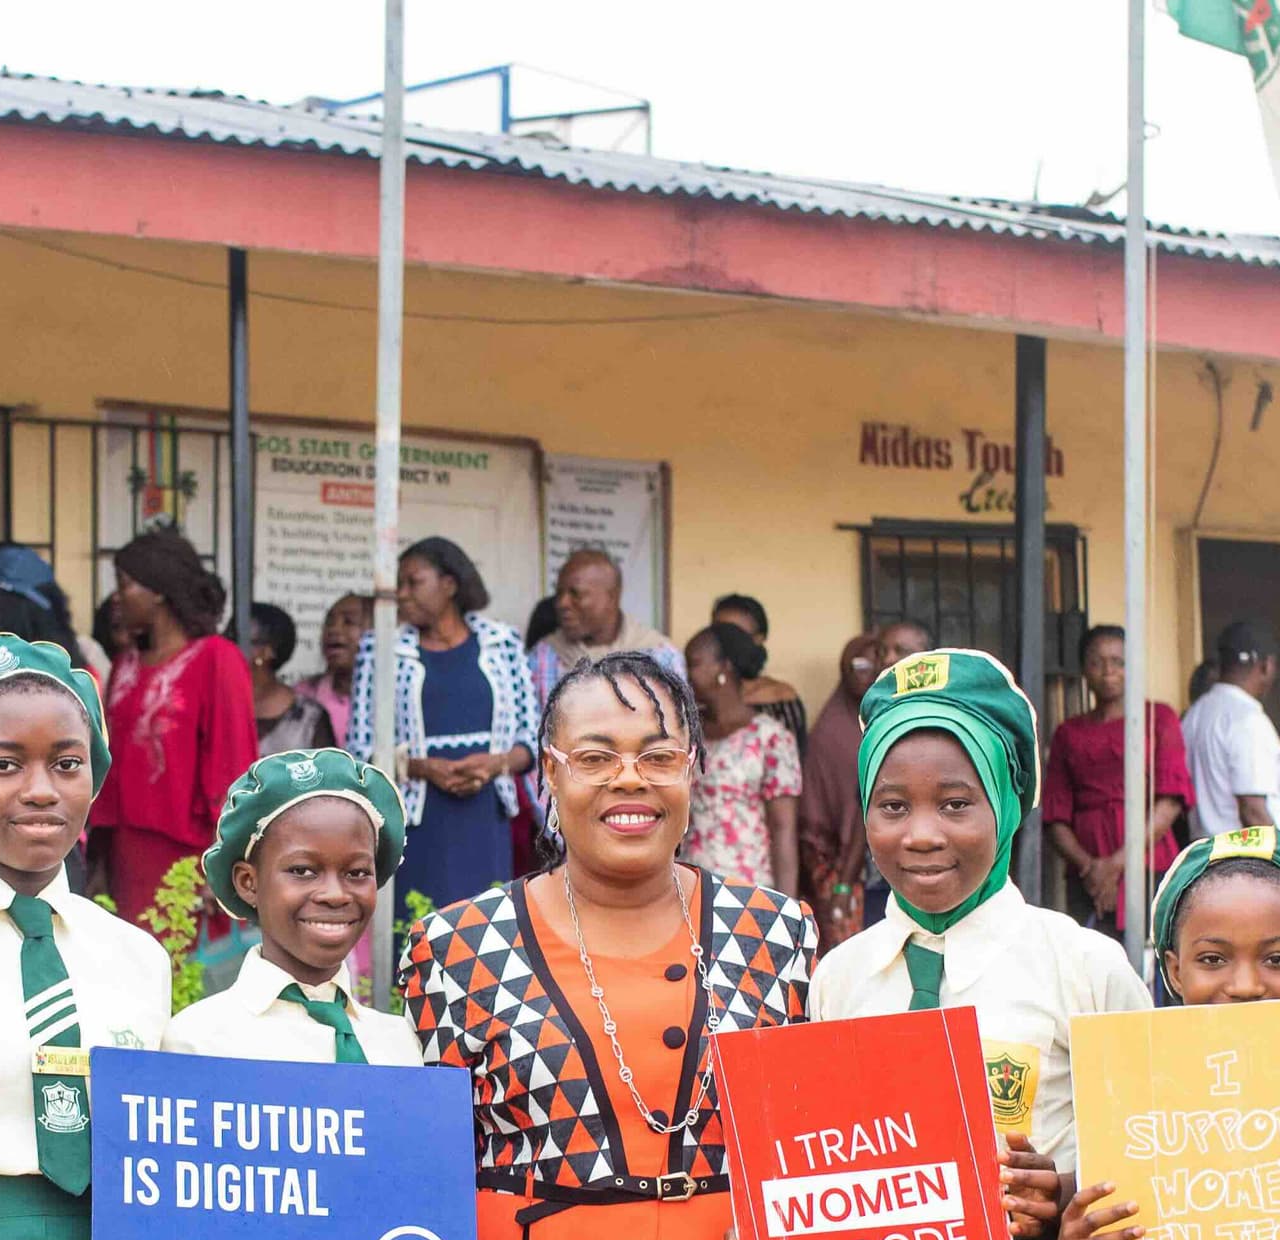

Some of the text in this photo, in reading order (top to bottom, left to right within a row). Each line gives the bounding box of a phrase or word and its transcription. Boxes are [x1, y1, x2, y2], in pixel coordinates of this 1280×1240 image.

[258, 437, 489, 470] GOS STATE GERNMENT
[272, 458, 362, 479] EDUCATION
[365, 466, 429, 485] DRICT
[961, 428, 1064, 477] Touh
[1207, 1051, 1240, 1096] I
[122, 1095, 365, 1155] THE FUTURE
[775, 1113, 917, 1175] I TRAIN
[124, 1156, 328, 1216] IS DIGITAL
[773, 1167, 948, 1231] WOMEN
